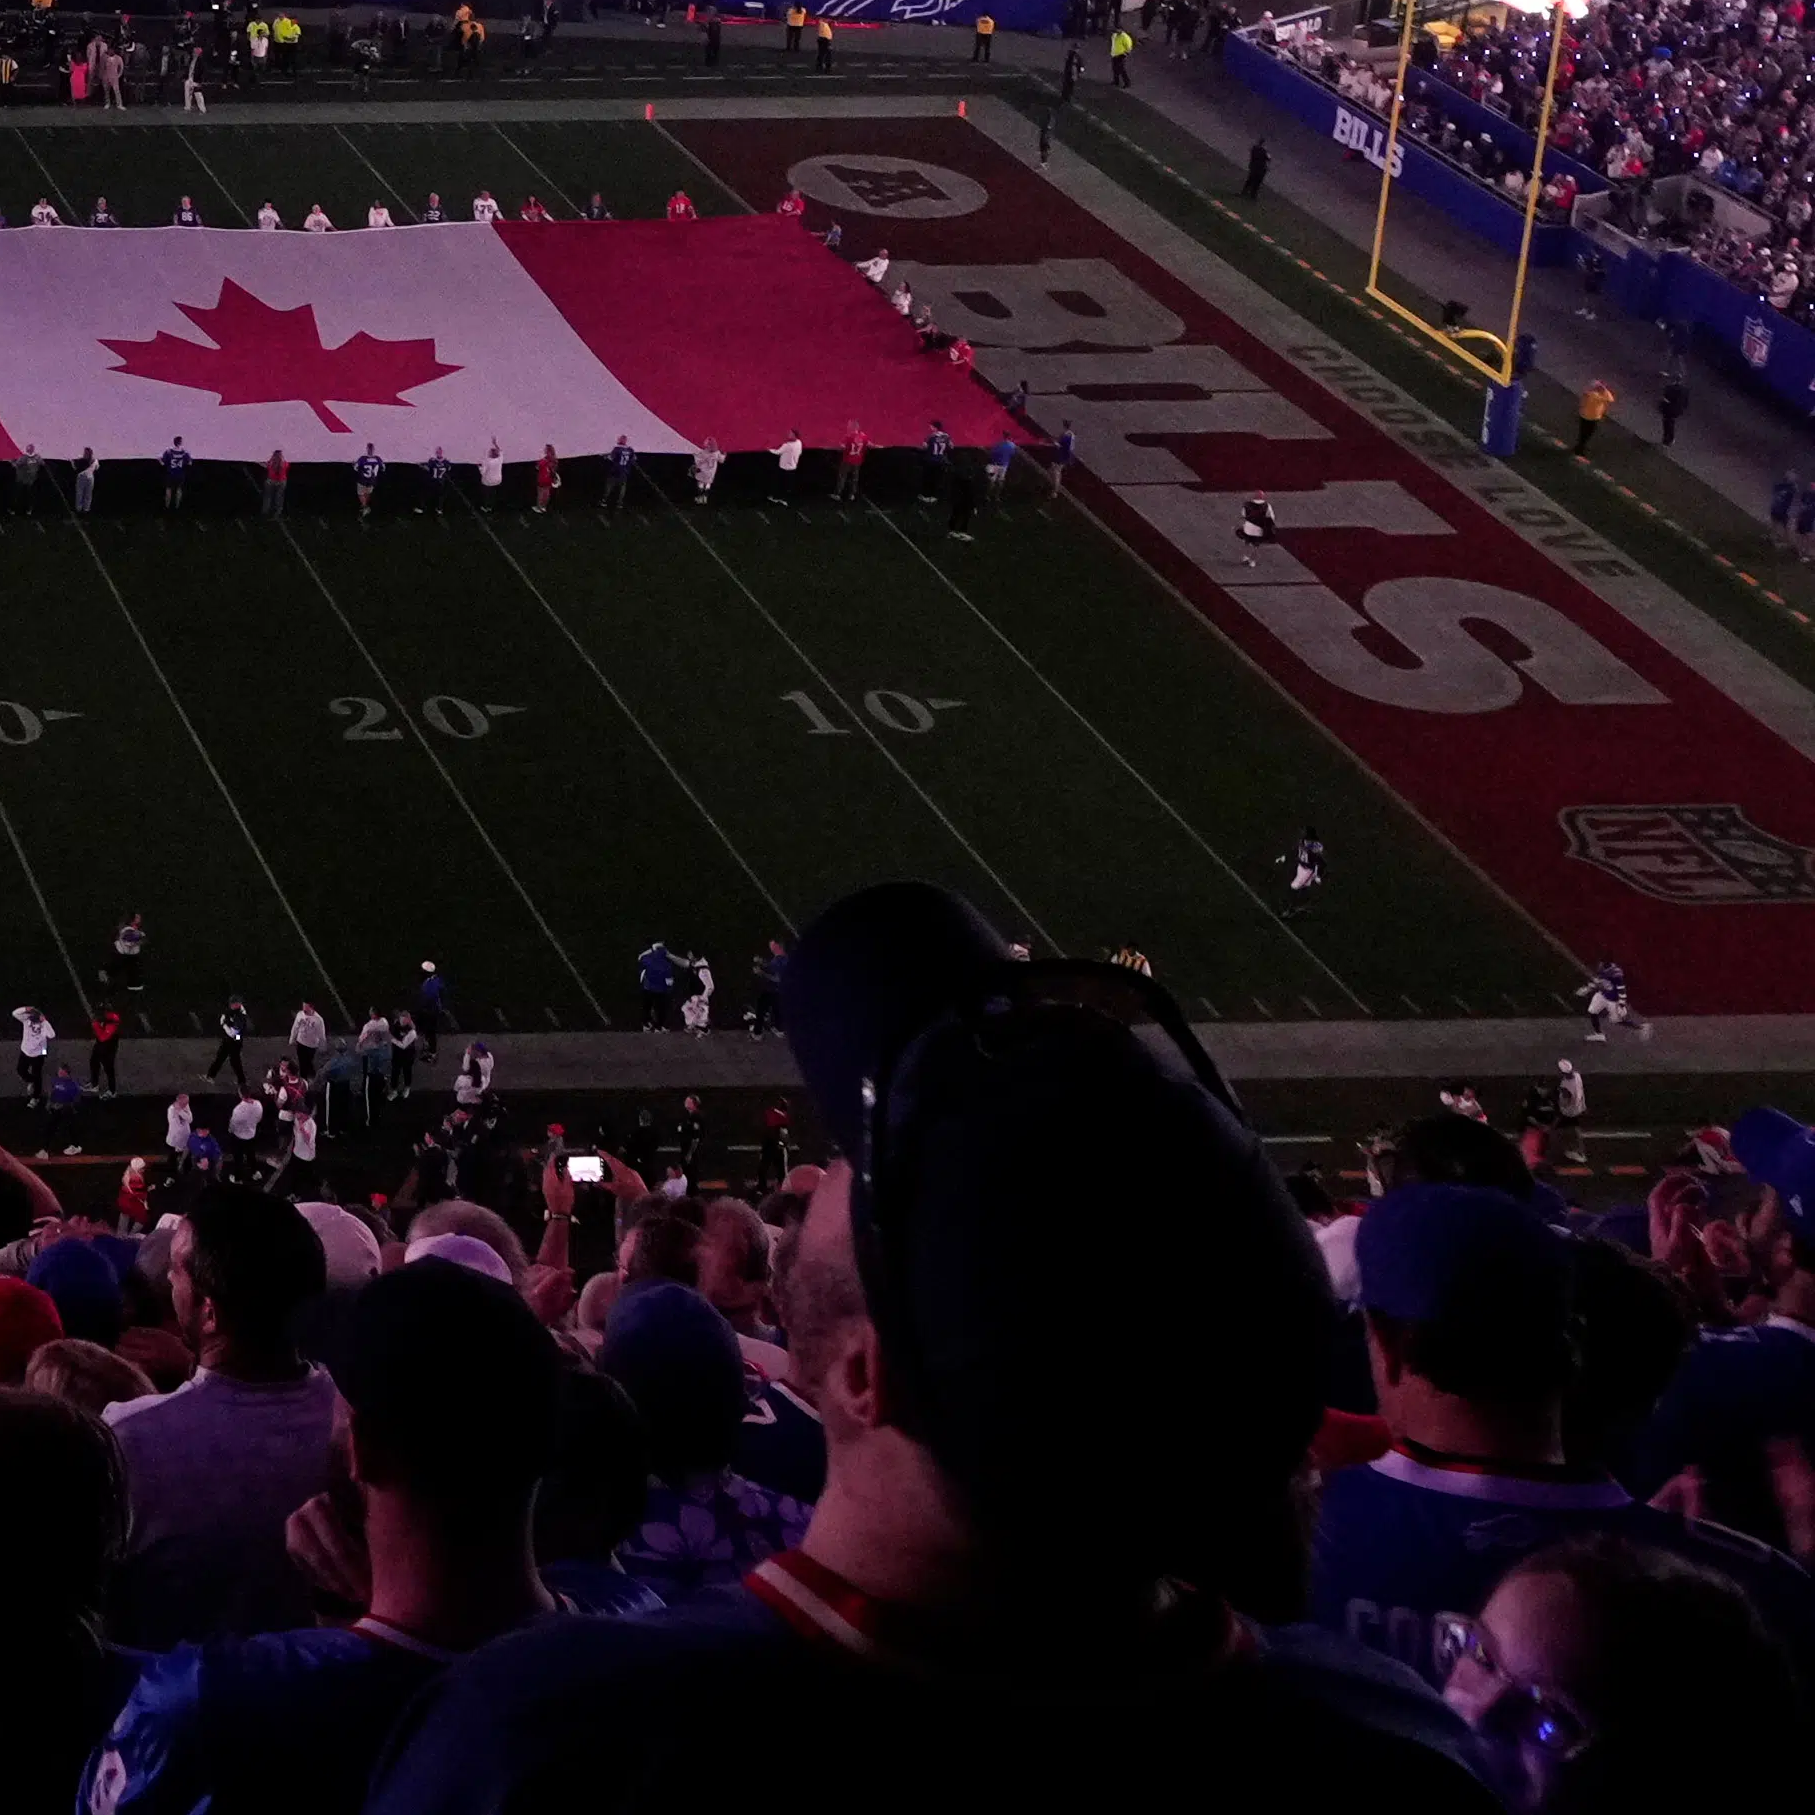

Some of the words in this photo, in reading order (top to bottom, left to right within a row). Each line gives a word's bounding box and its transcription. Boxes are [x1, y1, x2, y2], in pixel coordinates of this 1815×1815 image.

[886, 256, 1673, 716] BILLS
[1285, 344, 1492, 471] CHOOSE
[1478, 486, 1638, 578] LOVE
[326, 692, 492, 741] 20
[778, 687, 939, 737] 10
